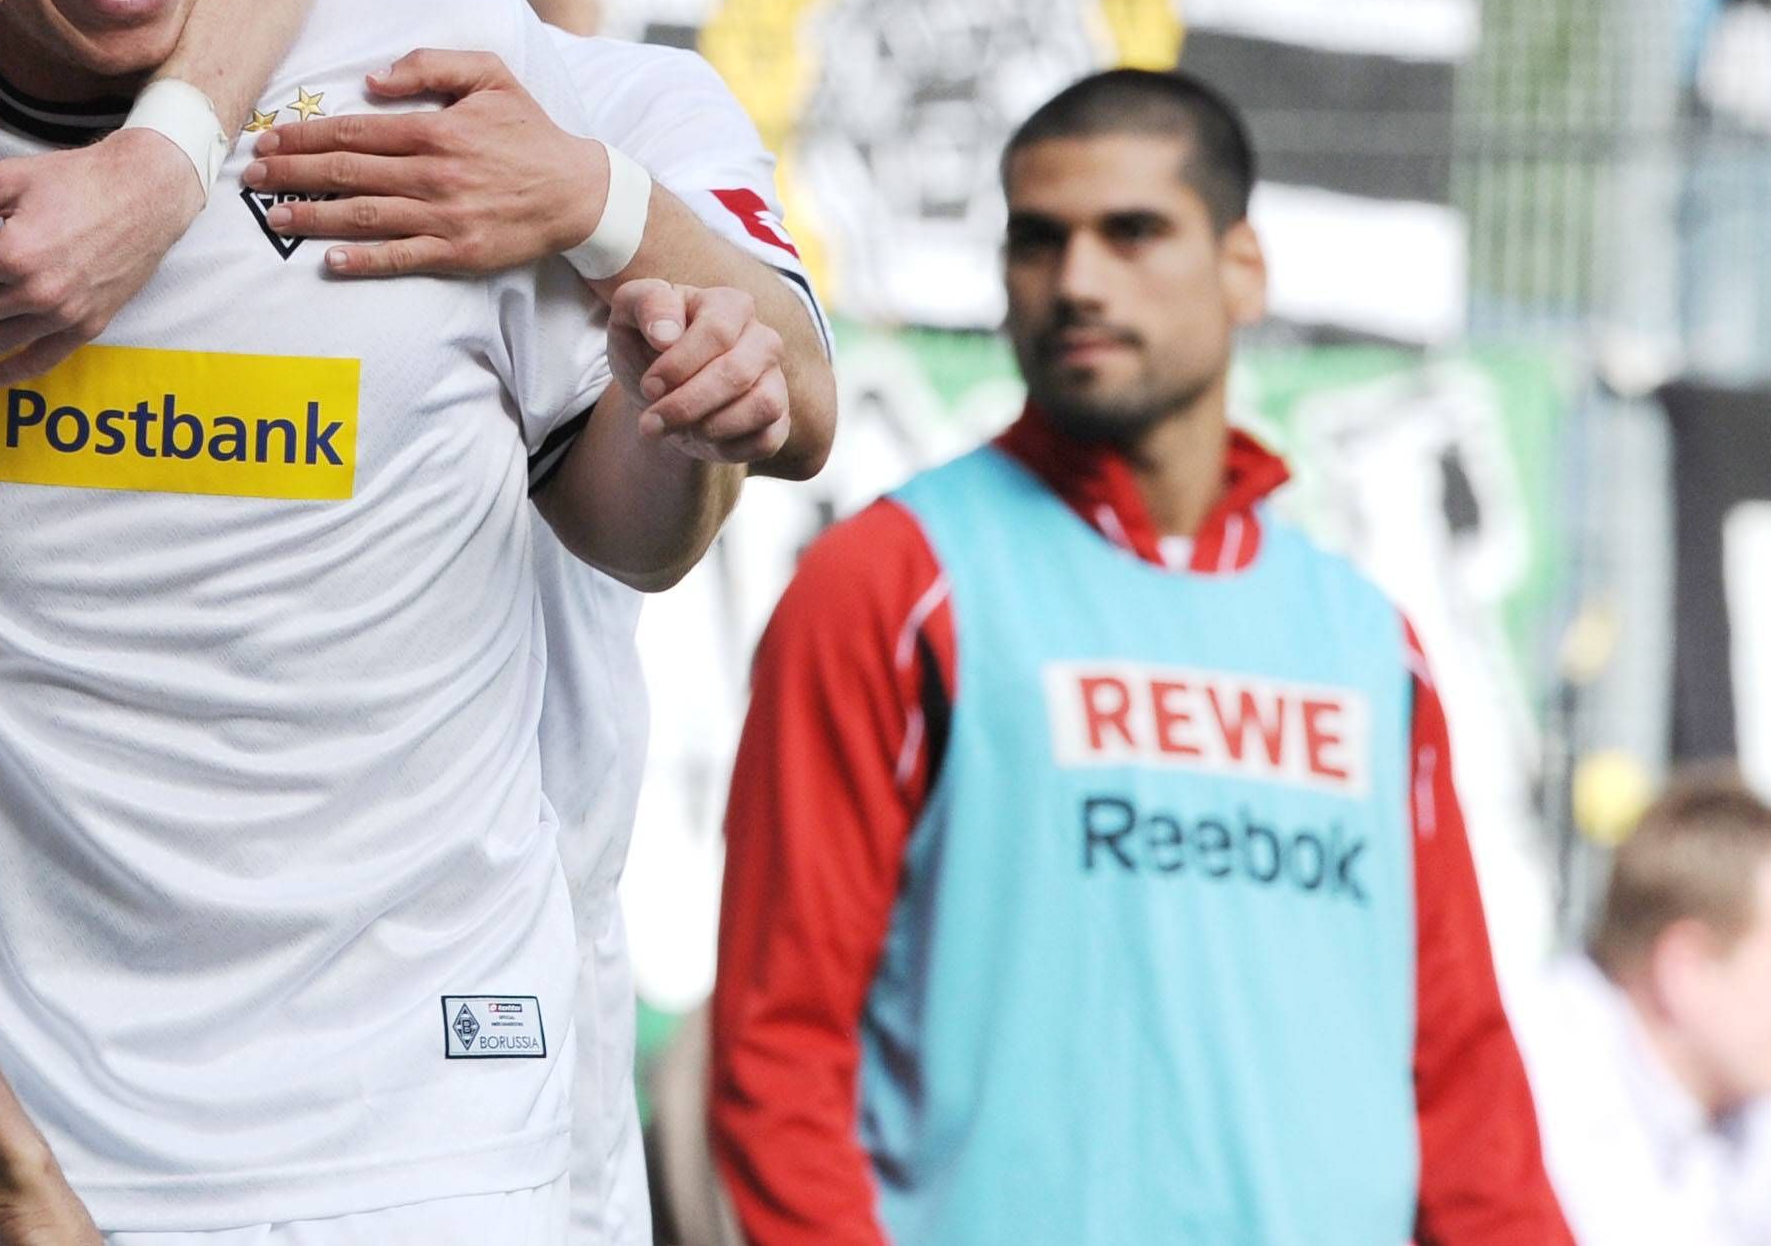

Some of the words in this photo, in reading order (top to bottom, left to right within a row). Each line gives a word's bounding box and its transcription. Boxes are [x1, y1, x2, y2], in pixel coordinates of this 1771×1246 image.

[6, 388, 344, 466] Postbank
[1079, 677, 1349, 780] REWE
[1083, 796, 1369, 906] Reebok
[479, 1036, 540, 1050] BORUSSIA
